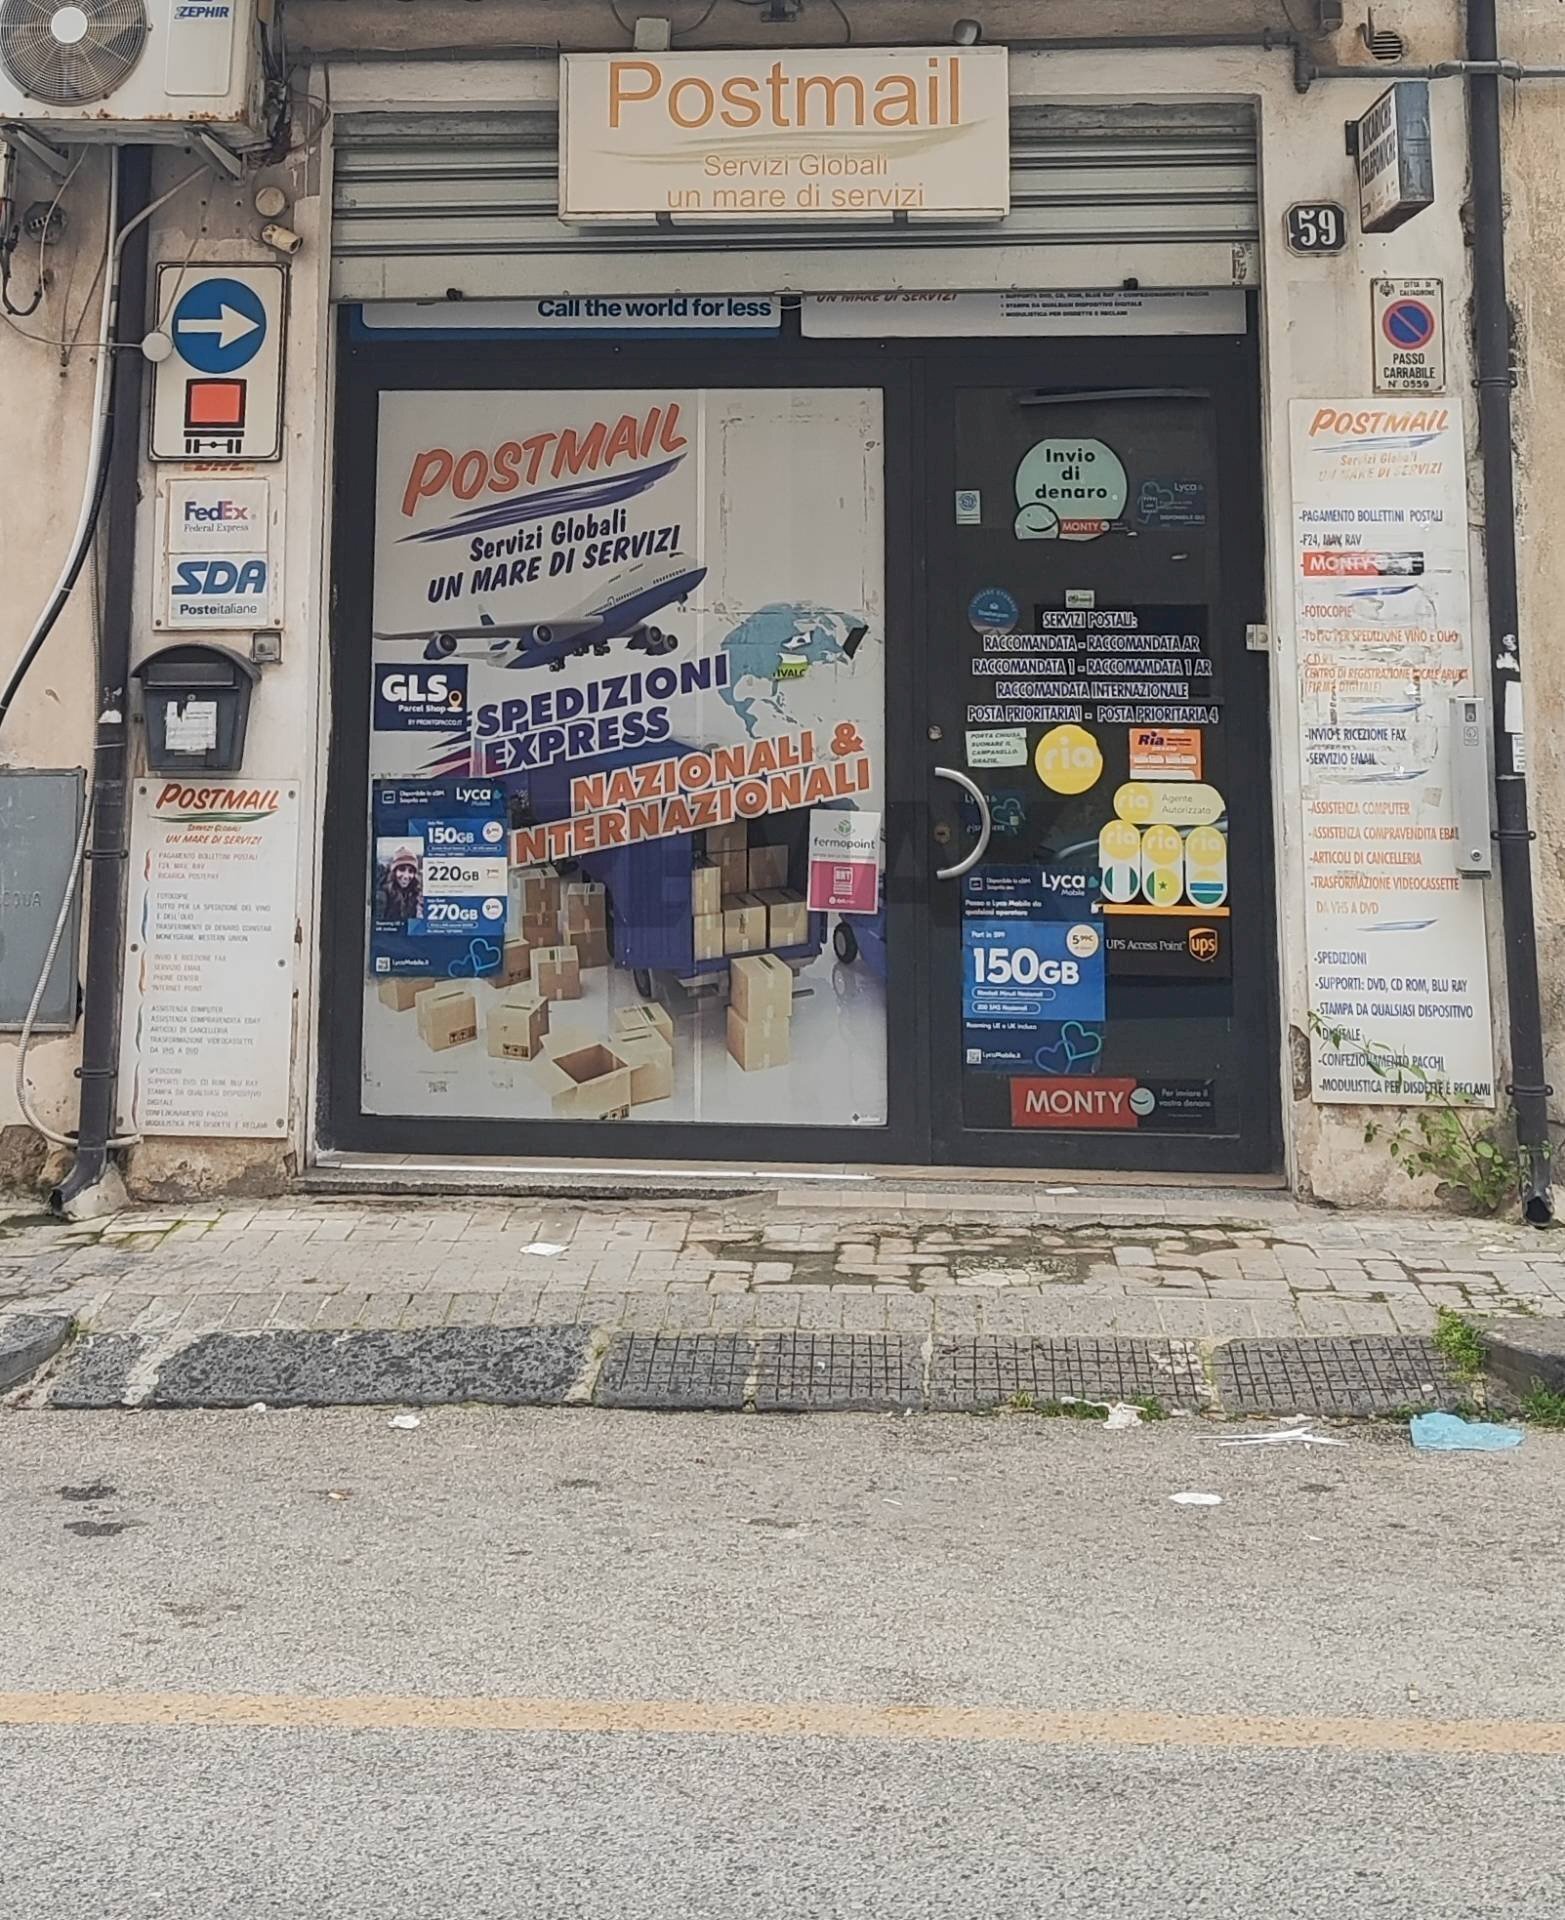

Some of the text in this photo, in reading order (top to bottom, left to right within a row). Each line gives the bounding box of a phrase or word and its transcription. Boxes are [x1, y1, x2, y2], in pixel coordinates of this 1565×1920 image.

[178, 7, 230, 18] ZEPHIR
[609, 57, 961, 128] Postmail
[704, 154, 887, 177] Servizi Globali
[667, 183, 924, 208] un mare di servizi
[1298, 209, 1336, 246] 59
[538, 296, 771, 317] Call the world for less
[1393, 353, 1425, 365] PASSO
[1384, 367, 1436, 379] CARRABILE
[1309, 409, 1449, 437] POSTMAIL
[401, 403, 688, 518] POSTMAIL
[1046, 448, 1095, 463] Invio
[1061, 466, 1080, 481] di
[1035, 484, 1107, 499] denaro
[1174, 482, 1197, 492] Lyca
[184, 501, 248, 522] FedEx
[1358, 510, 1404, 522] BOLLETTINI
[1409, 510, 1443, 522] POSTALI
[184, 524, 249, 534] Federal Express
[470, 508, 626, 562] Servizi Globali
[1062, 522, 1100, 532] MONTY
[1345, 534, 1362, 546] RAV
[428, 524, 680, 603] UN MARE DI SERVIZI
[171, 560, 267, 595] SDA
[180, 603, 257, 615] Posteitaliane
[1043, 612, 1086, 628] SERVIZI
[984, 635, 1200, 652] RACCOMANDATA RACCOMANDATA AR
[1405, 630, 1427, 642] VINO
[972, 658, 1066, 674] RACCOMANDATA
[1067, 659, 1075, 674] 1
[1185, 660, 1192, 675] 1
[1194, 660, 1213, 676] AR
[1338, 667, 1346, 679] DI
[1347, 668, 1410, 680] REGISTRAZIONE
[382, 674, 448, 702] GLS
[476, 655, 730, 737] SPEDIZIONI
[996, 682, 1189, 699] RACCOMANDATA INTERNAZIONALE
[425, 705, 446, 714] Shop
[968, 705, 1005, 721] POSTA
[1097, 706, 1136, 722] POSTA
[1136, 707, 1208, 723] PRIORITARIA
[1209, 708, 1219, 723] 4
[485, 707, 671, 774] EXPRESS
[1138, 731, 1164, 746] Ria
[1343, 728, 1388, 741] RICEZIONE
[1391, 728, 1407, 741] FAX
[1044, 736, 1095, 770] ria
[575, 721, 864, 812] NAZIONALI &
[156, 783, 279, 810] POSTMAIL
[456, 787, 491, 802] Lyca
[1119, 790, 1149, 808] ria
[1162, 794, 1192, 803] Agente
[1162, 806, 1211, 814] Autorizzato
[1362, 802, 1410, 815] COMPUTER
[166, 835, 263, 844] UN MARE DI SERVIZI
[428, 827, 474, 843] 150GB
[1106, 828, 1136, 845] ria
[1147, 831, 1179, 849] ria
[1190, 833, 1221, 849] ria
[1363, 827, 1437, 840] COMPRAVENDITA
[814, 837, 875, 850] fermopoint
[1354, 852, 1364, 864] DI
[1366, 852, 1422, 865] CANCELLERIA
[428, 866, 479, 881] 220GB
[1042, 872, 1085, 891] Lyca
[1393, 877, 1460, 891] VIDEOCASSETTE
[427, 904, 478, 920] 270GB
[1351, 903, 1358, 914] A
[1359, 902, 1379, 914] DVD
[1106, 939, 1183, 950] UPS Access Point
[1191, 937, 1215, 956] ups
[973, 947, 1079, 984] 150GB
[1367, 978, 1388, 993] DVD,
[1391, 979, 1403, 992] CD
[1406, 978, 1430, 994] ROM,
[1432, 978, 1448, 992] BLU
[1452, 980, 1467, 993] RAY
[1356, 1002, 1369, 1016] DA
[1371, 1004, 1415, 1017] QUALSIASI
[1418, 1004, 1473, 1018] DISPOSITIVO
[1412, 1055, 1445, 1071] PACCHI
[1162, 1088, 1174, 1097] Per
[1385, 1081, 1400, 1094] PER
[1025, 1090, 1124, 1114] MONTY
